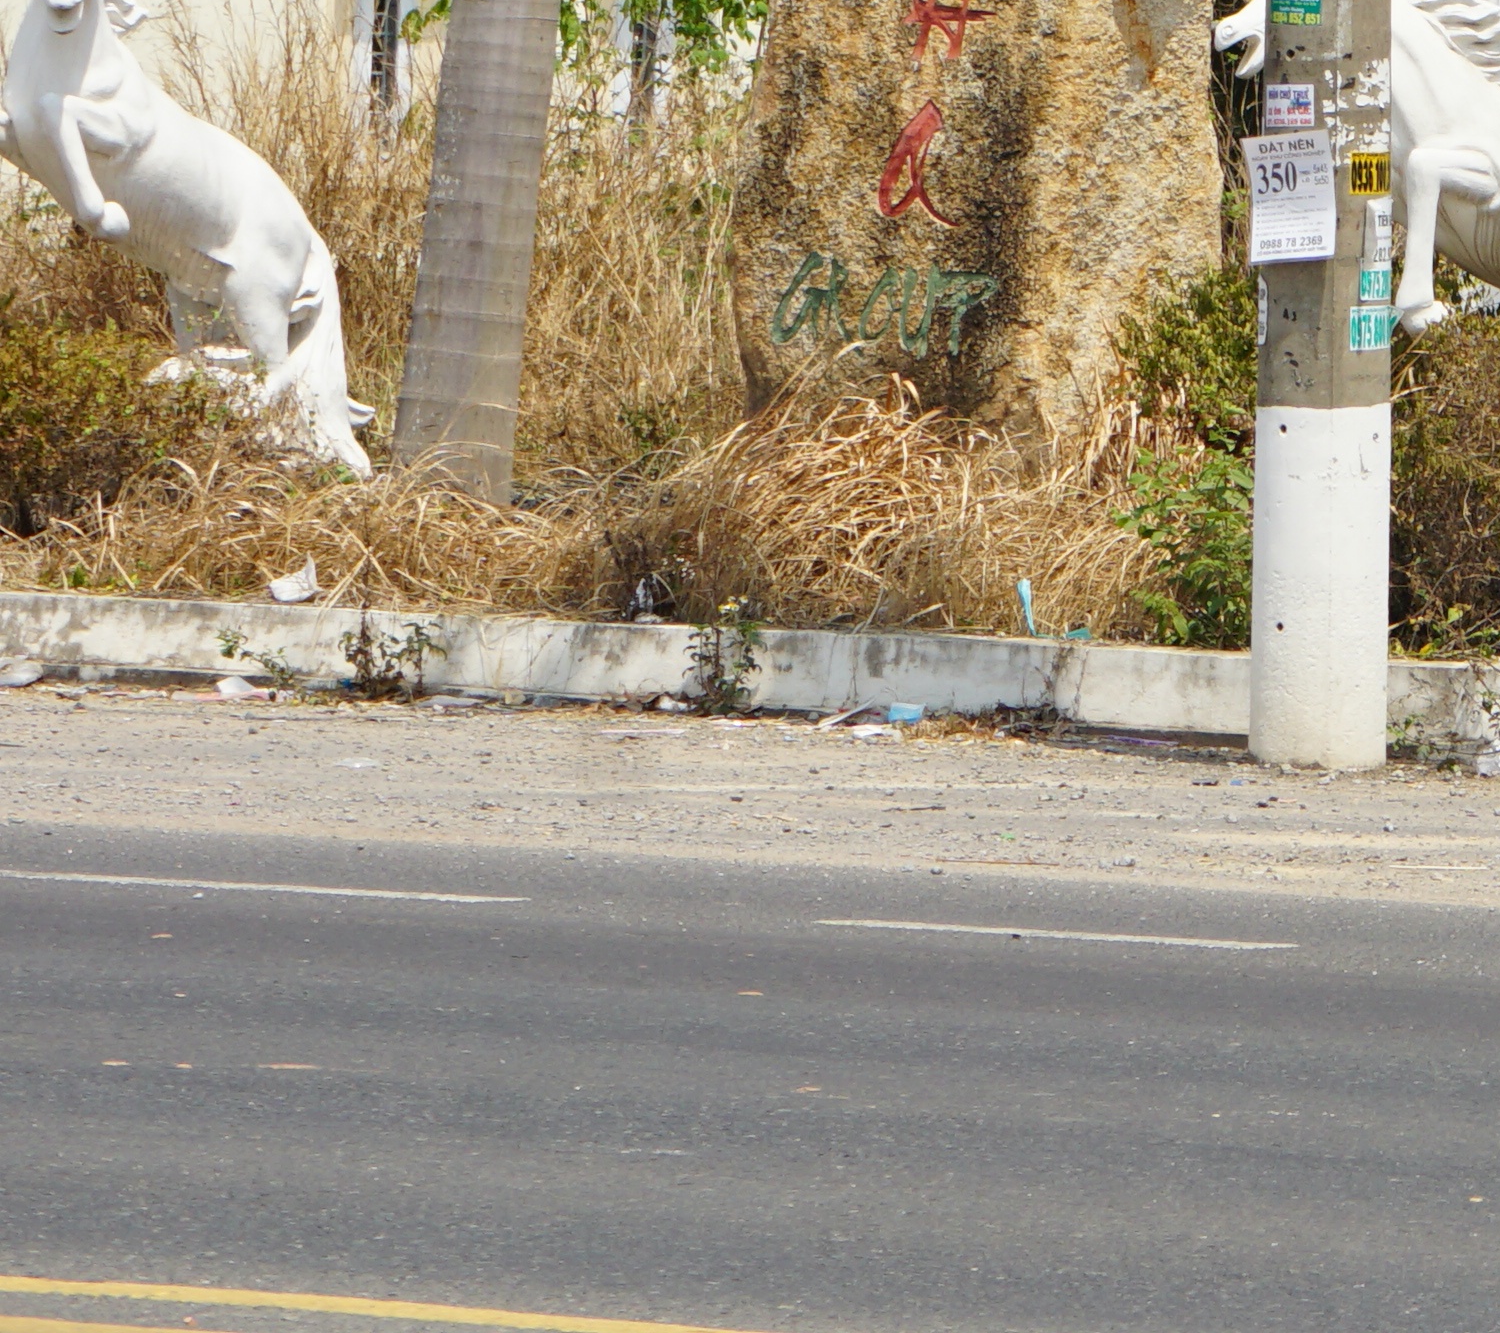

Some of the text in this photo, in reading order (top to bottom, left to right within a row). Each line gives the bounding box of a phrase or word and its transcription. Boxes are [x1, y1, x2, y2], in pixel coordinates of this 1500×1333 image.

[1256, 161, 1297, 194] 350
[1285, 236, 1297, 247] 78
[1300, 235, 1323, 246] 2369
